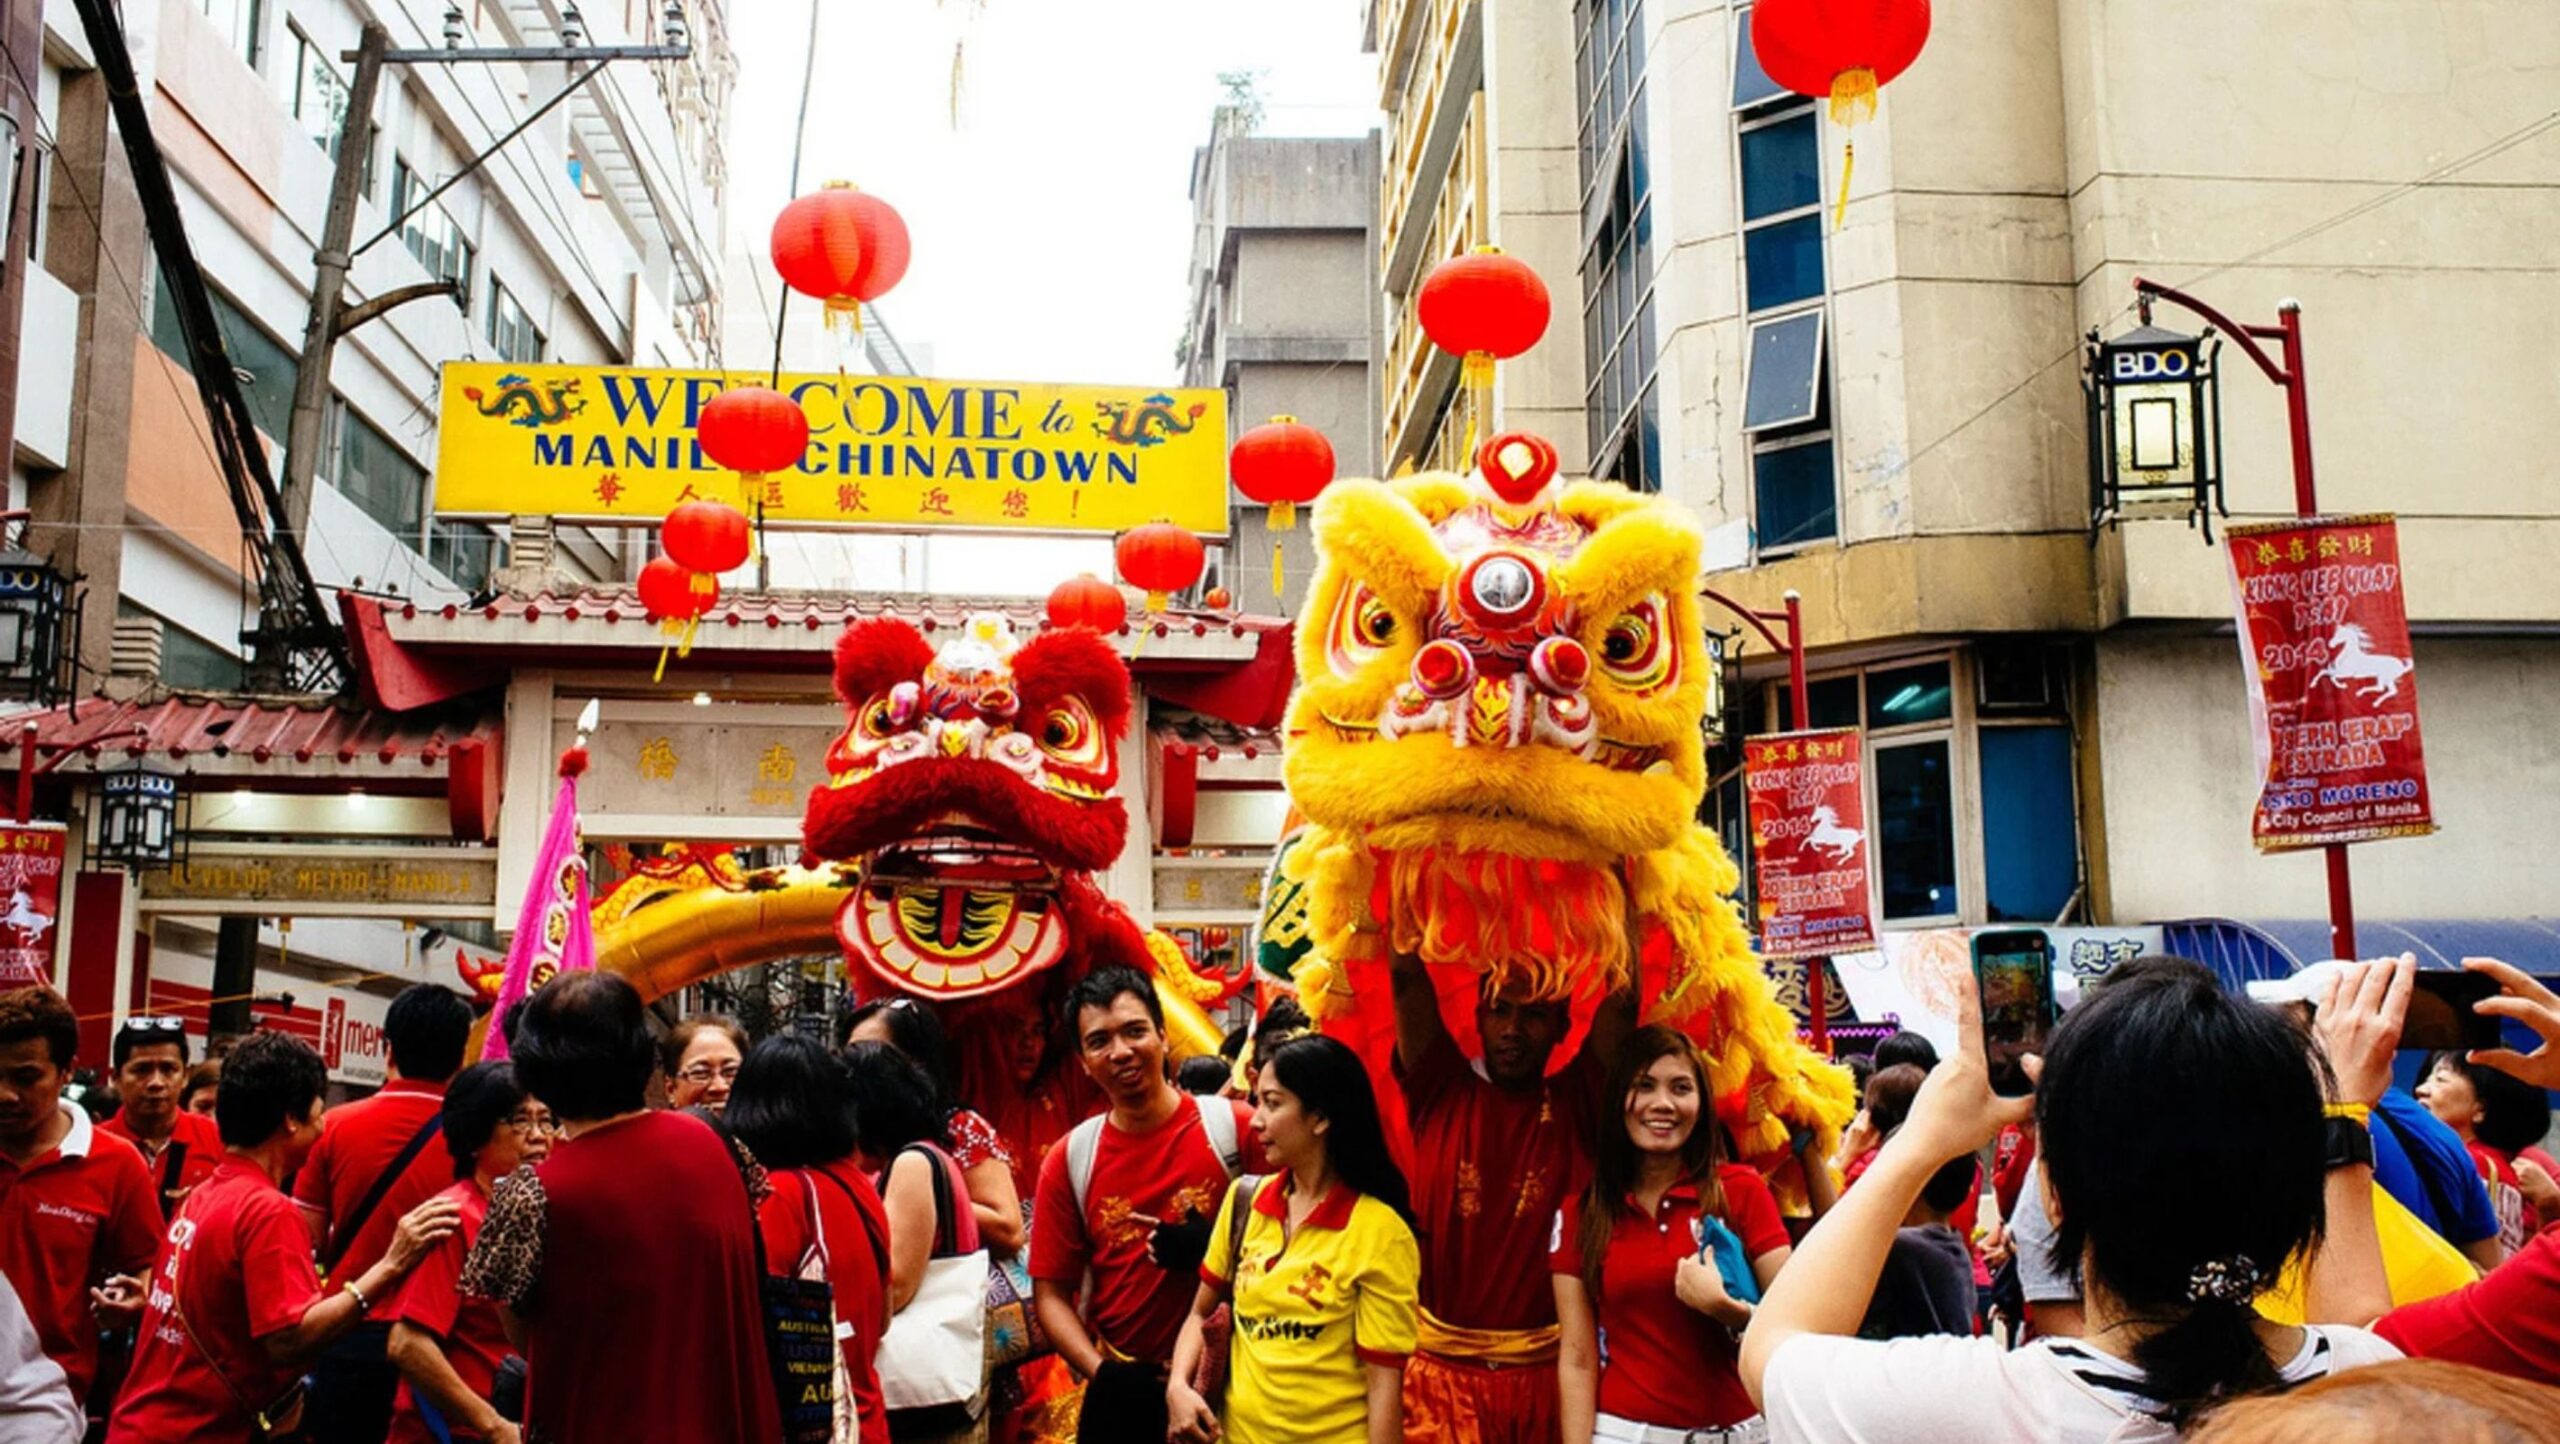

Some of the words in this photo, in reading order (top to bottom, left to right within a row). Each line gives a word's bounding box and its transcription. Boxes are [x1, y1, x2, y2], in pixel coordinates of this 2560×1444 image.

[2114, 349, 2190, 378] BDO
[599, 375, 1023, 440] WECOME
[1038, 399, 1076, 434] to
[534, 434, 719, 470] MANIL
[795, 441, 1137, 484] CHINATOWN
[0, 568, 41, 592] DO
[2263, 637, 2329, 671] 2014
[2283, 741, 2385, 776] ESTRADA
[2263, 791, 2313, 810] ISKO
[2320, 779, 2418, 805] MORENO
[1760, 815, 1811, 840] 2014
[2272, 813, 2299, 828] City
[2303, 808, 2354, 826] Council
[2357, 805, 2370, 819] of
[2375, 802, 2421, 818] Manila
[345, 1020, 385, 1057] mer
[801, 1383, 833, 1404] AU
